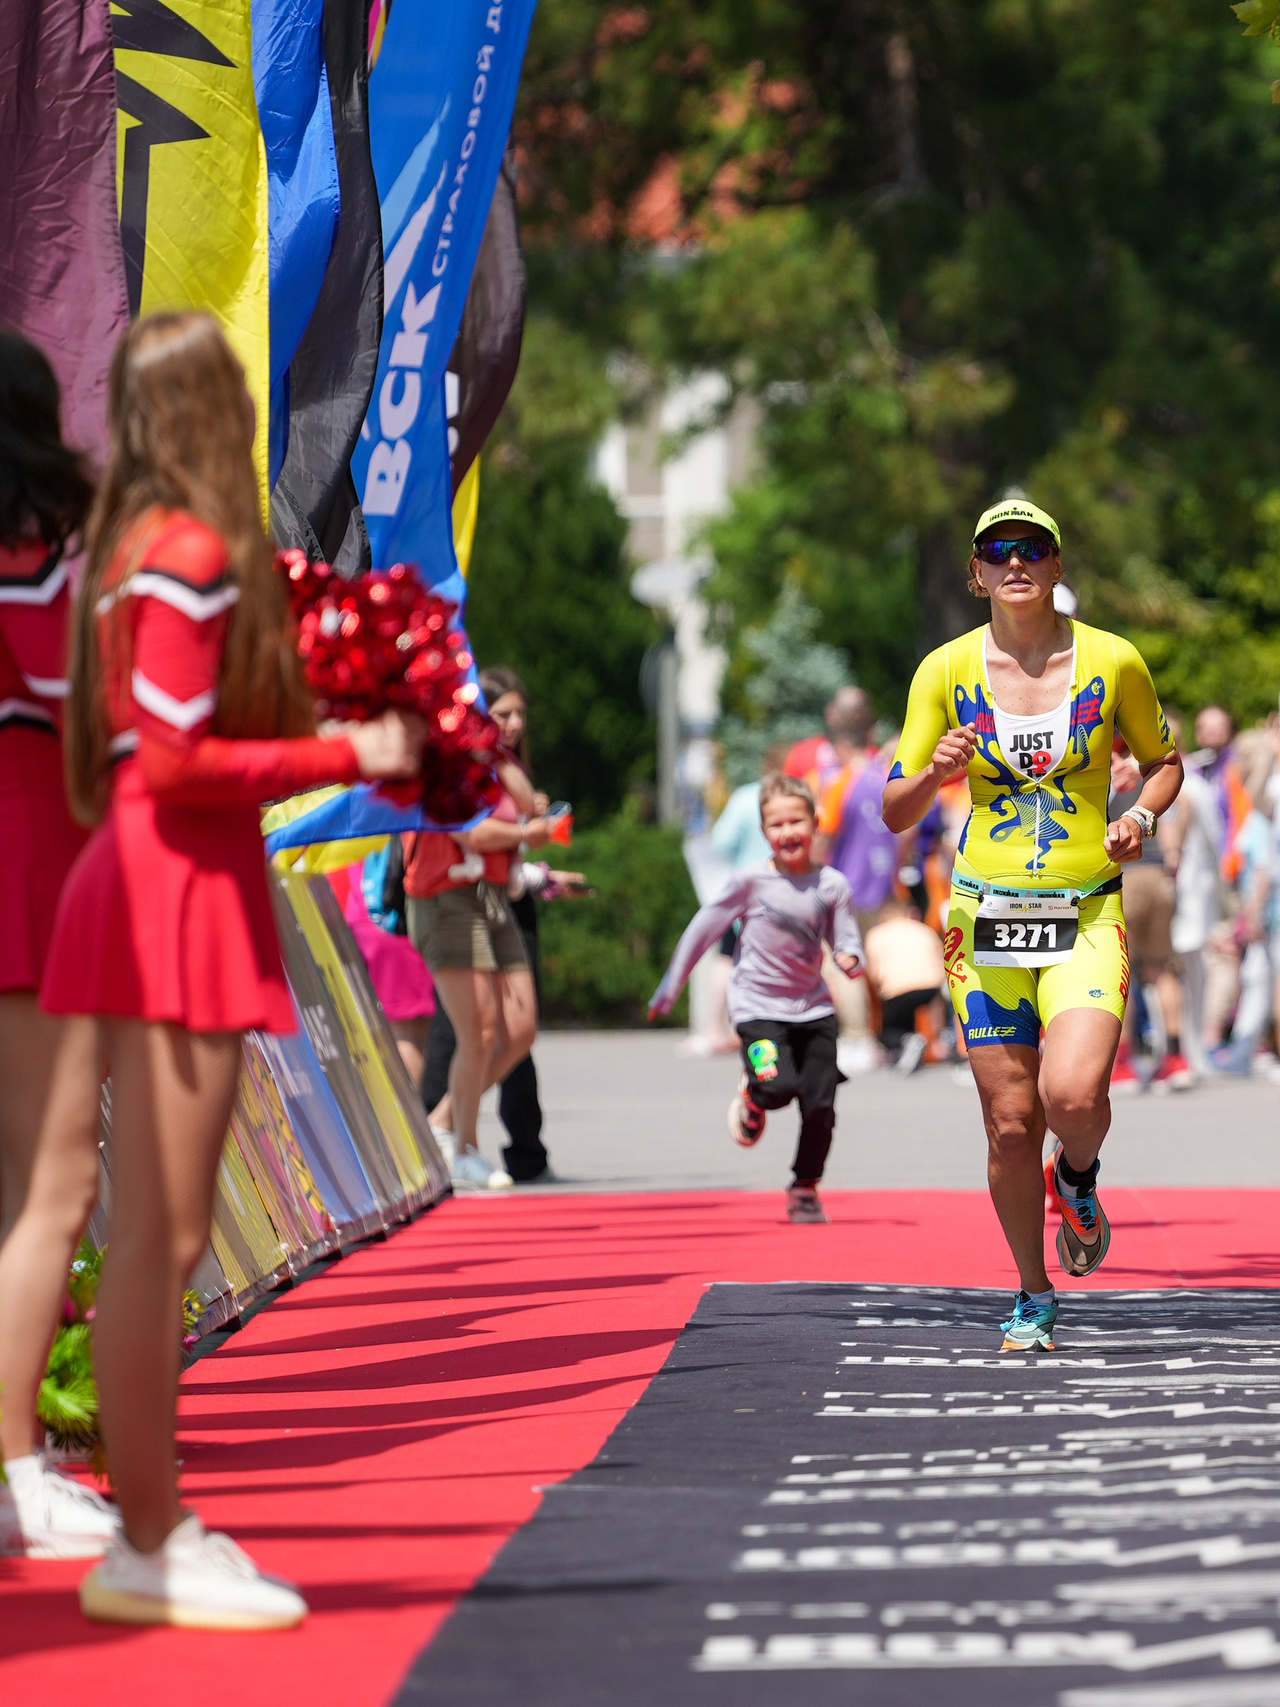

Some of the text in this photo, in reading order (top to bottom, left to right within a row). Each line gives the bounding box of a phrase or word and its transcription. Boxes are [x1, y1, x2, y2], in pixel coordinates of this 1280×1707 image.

[432, 44, 496, 277] СТРАХОВОЙ
[362, 281, 442, 516] ВСК
[1010, 731, 1054, 752] JUST
[994, 923, 1057, 948] 3271
